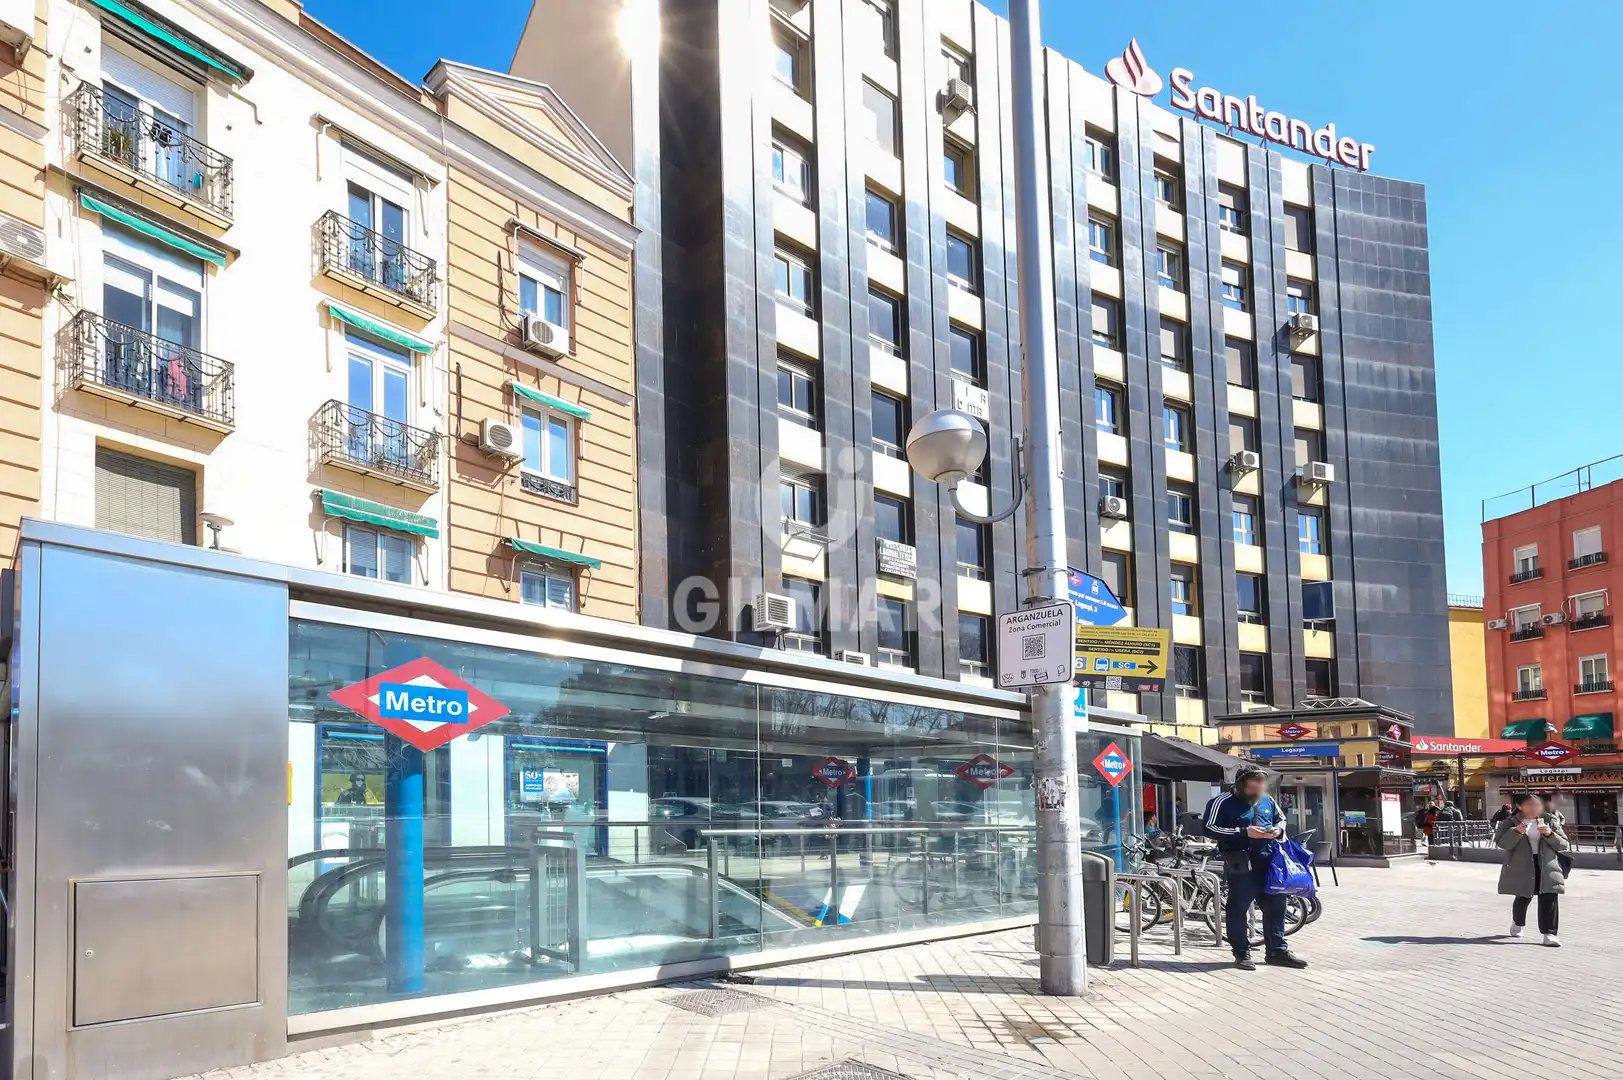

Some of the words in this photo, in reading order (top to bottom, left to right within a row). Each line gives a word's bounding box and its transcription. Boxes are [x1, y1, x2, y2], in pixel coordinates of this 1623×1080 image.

[1170, 67, 1375, 171] Santander
[1006, 608, 1063, 625] ARGANZUELA
[1026, 618, 1061, 630] Comercial
[385, 690, 462, 716] Metro
[1430, 741, 1481, 752] Santander
[1104, 758, 1123, 770] Metro
[822, 767, 843, 776] Metro
